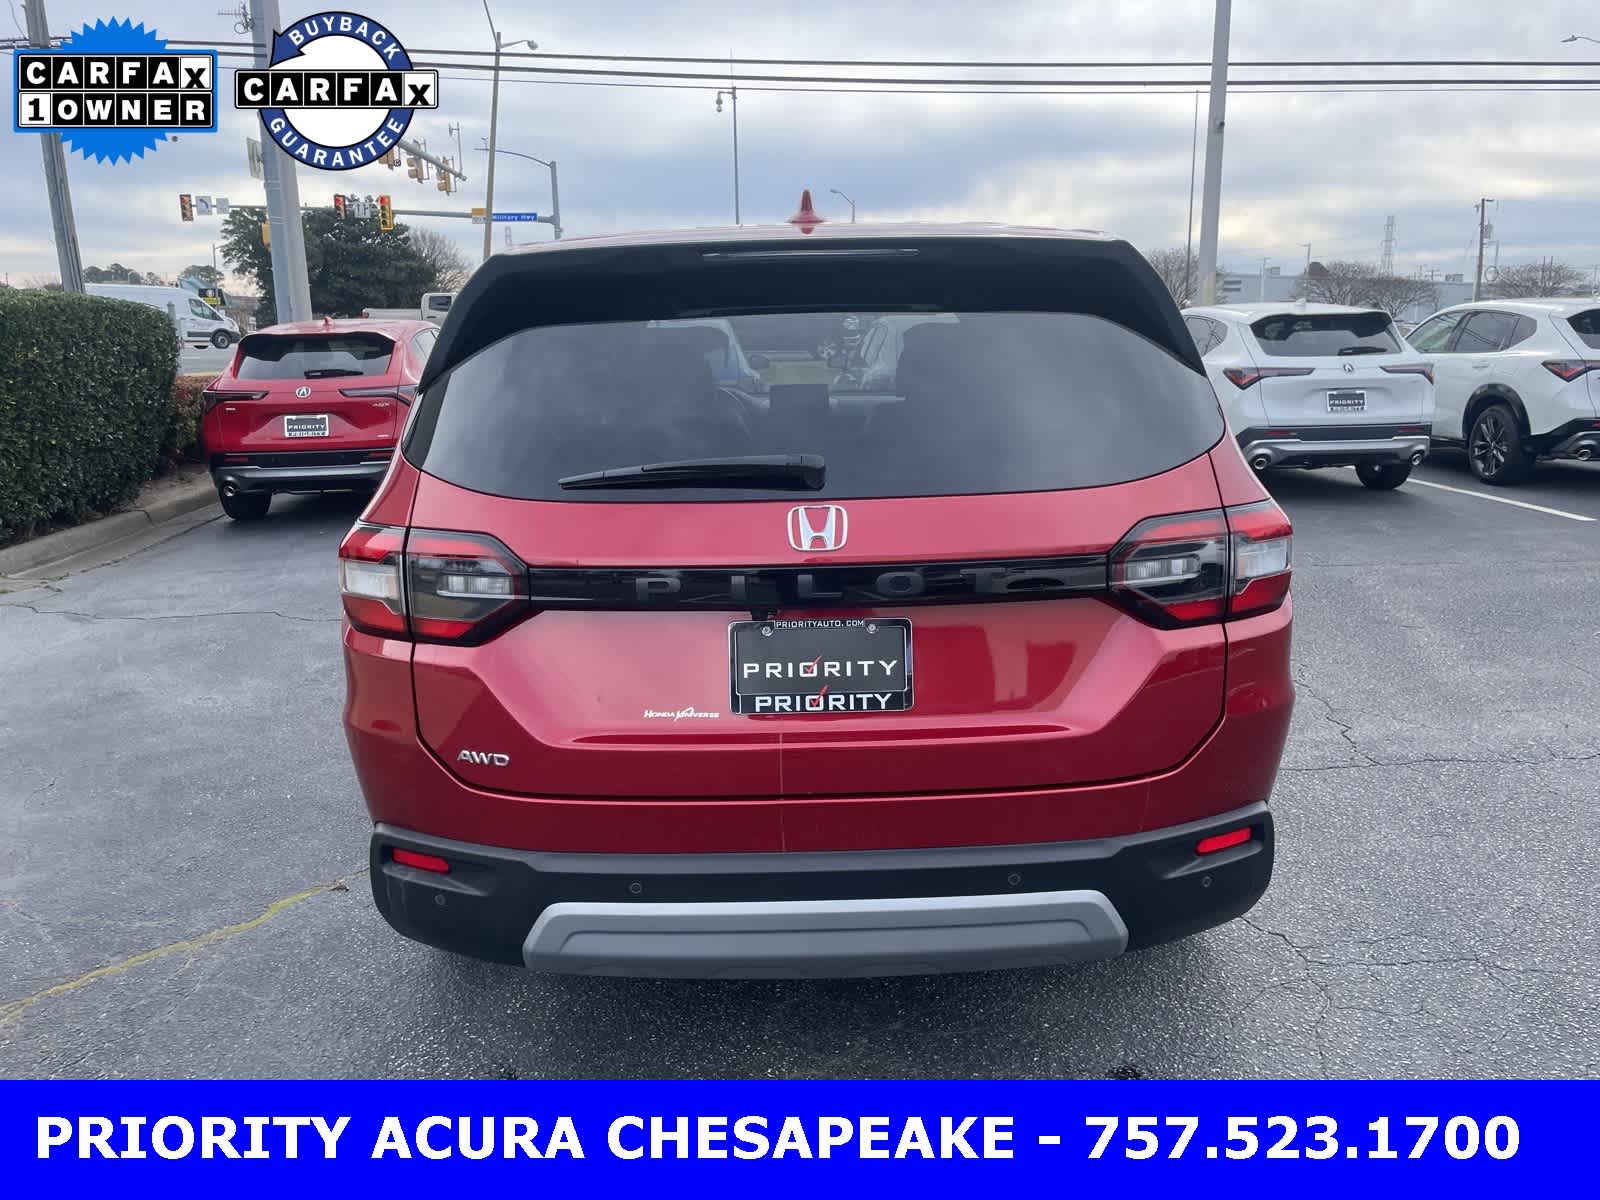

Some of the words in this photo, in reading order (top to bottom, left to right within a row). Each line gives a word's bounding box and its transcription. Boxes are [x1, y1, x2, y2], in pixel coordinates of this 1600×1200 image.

[634, 567, 1009, 602] PILOT
[743, 659, 898, 679] PRIORITY
[755, 693, 892, 712] PRIORITY
[456, 749, 510, 767] AWD
